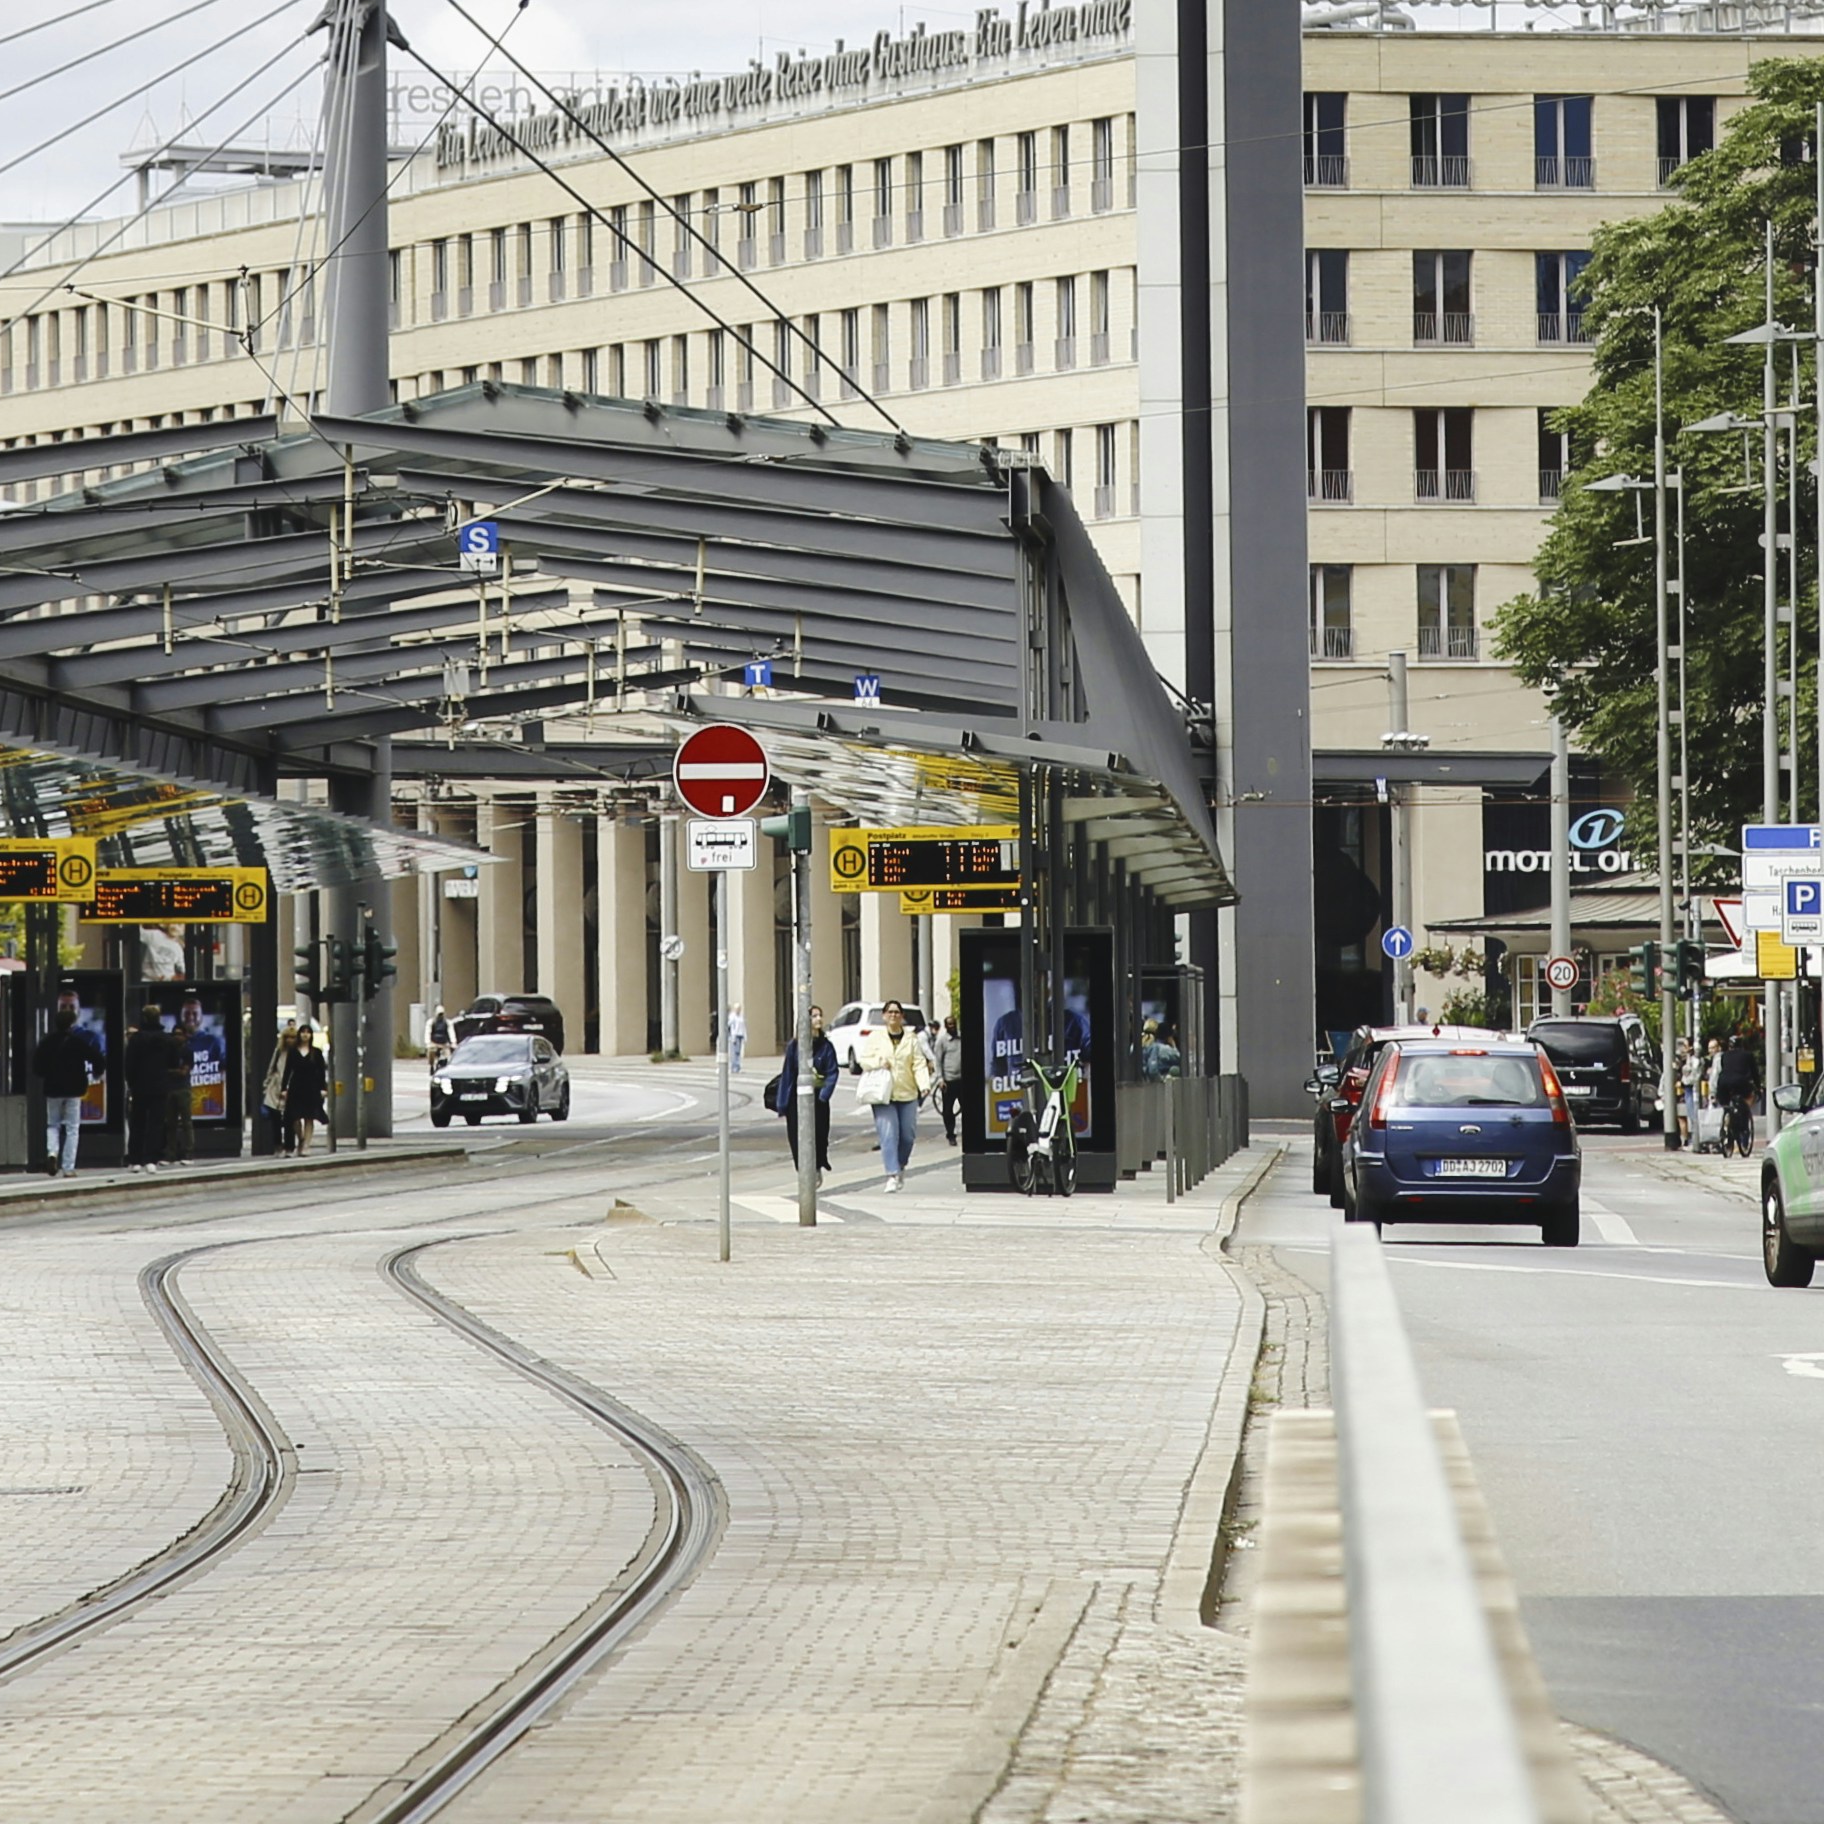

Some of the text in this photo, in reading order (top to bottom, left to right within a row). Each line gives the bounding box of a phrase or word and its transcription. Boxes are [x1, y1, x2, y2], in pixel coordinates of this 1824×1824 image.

[387, 72, 535, 114] resden
[467, 526, 490, 553] S
[749, 664, 766, 684] T
[856, 678, 878, 697] W
[711, 851, 732, 862] frei
[842, 852, 857, 872] H
[68, 861, 83, 880] H
[243, 888, 256, 906] H
[1795, 885, 1815, 912] P
[1554, 966, 1571, 980] 20
[1478, 1160, 1504, 1173] 2702
